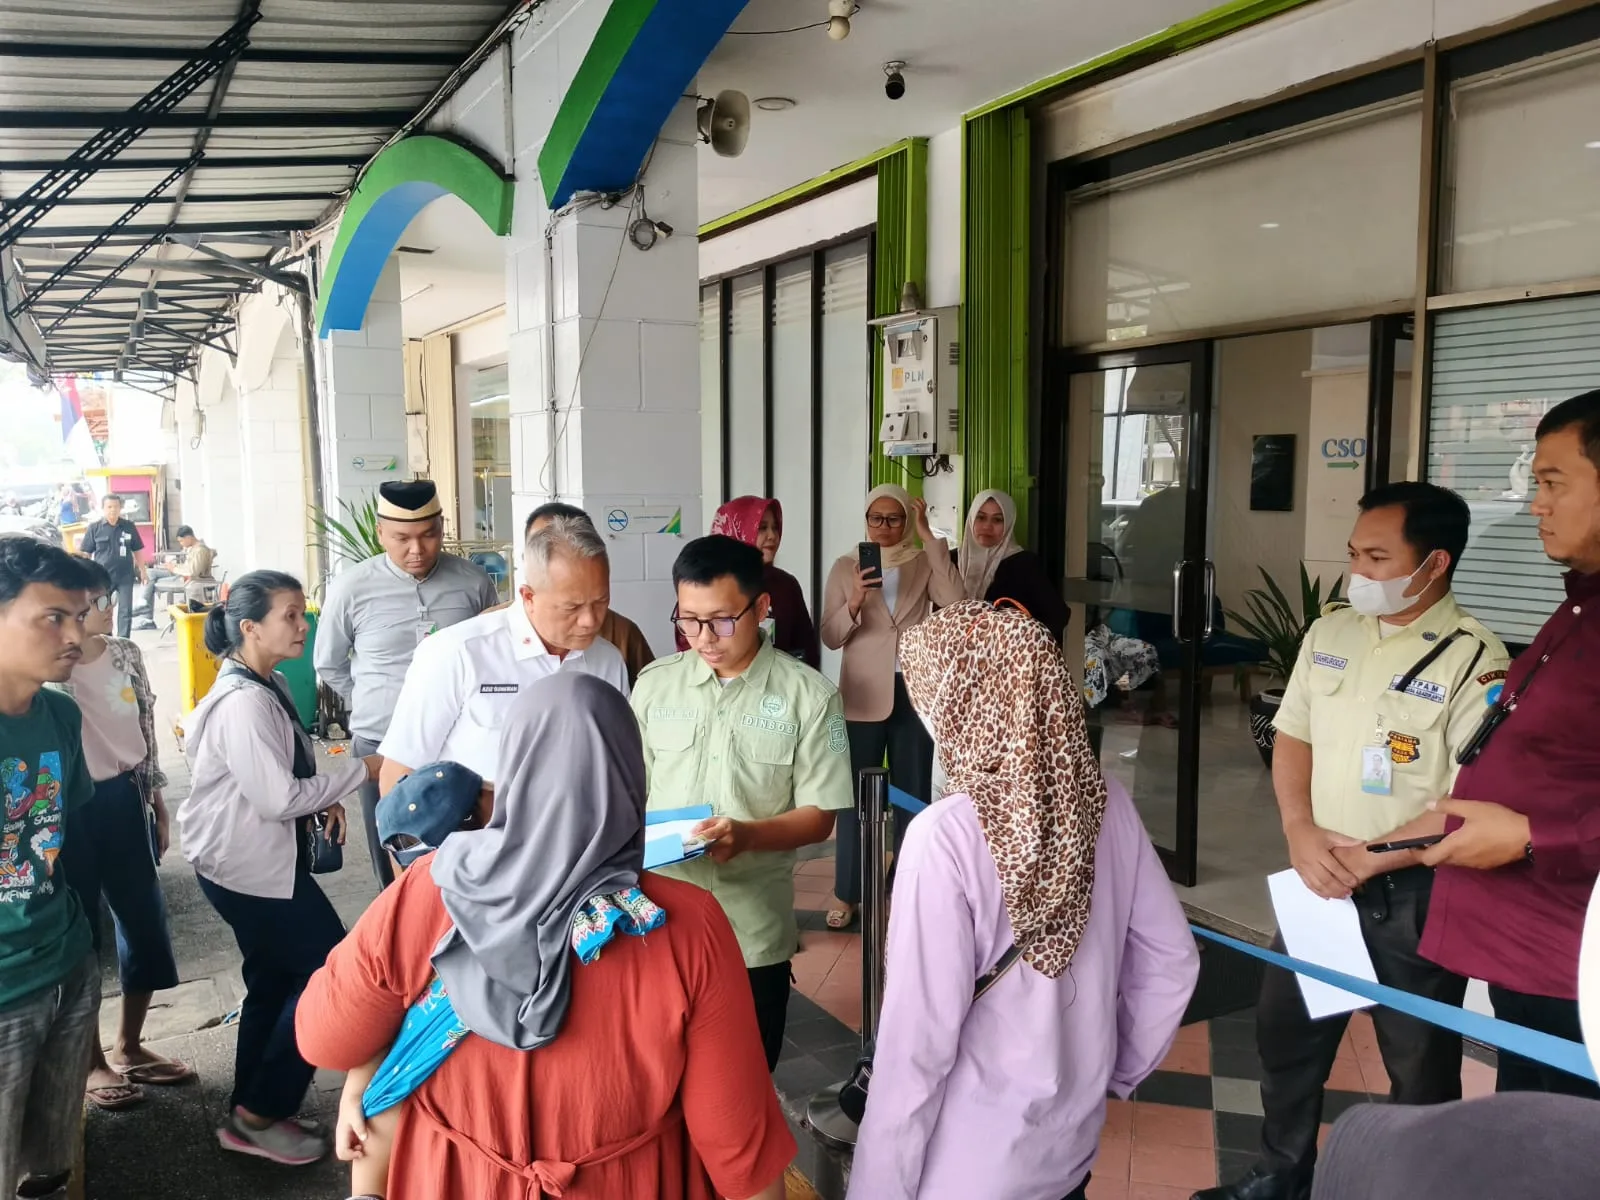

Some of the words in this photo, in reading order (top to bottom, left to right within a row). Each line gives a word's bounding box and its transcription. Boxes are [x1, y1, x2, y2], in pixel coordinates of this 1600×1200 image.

[905, 370, 924, 383] PLN
[1321, 438, 1366, 458] CSO
[745, 716, 794, 734] DINSOS
[0, 888, 32, 903] URFING
